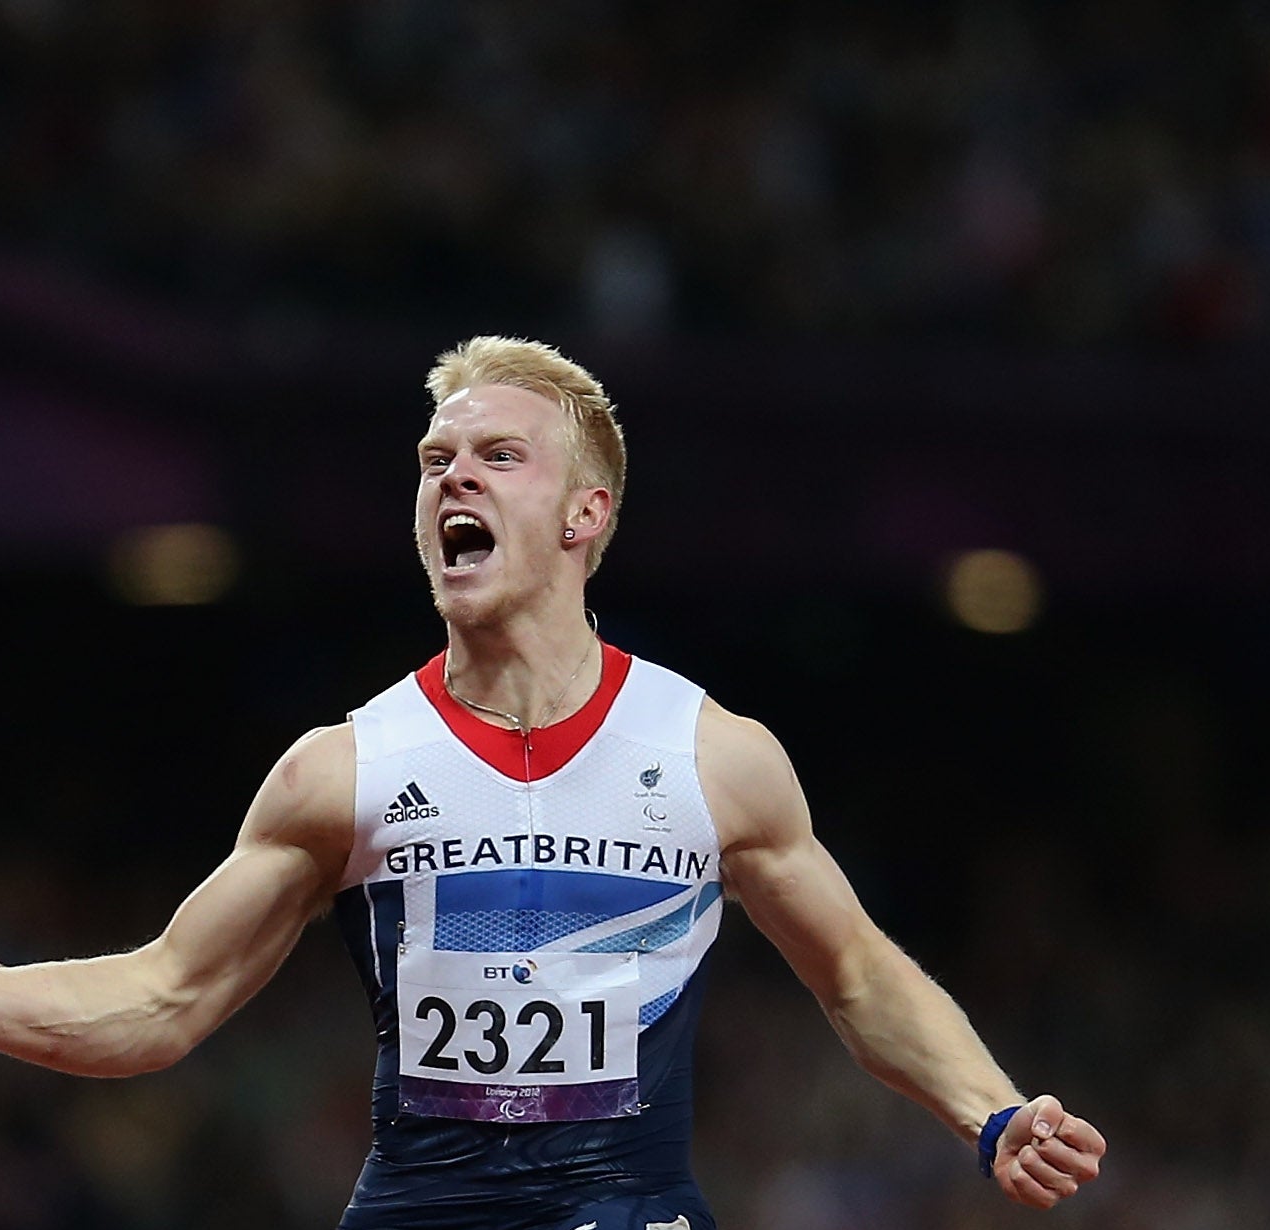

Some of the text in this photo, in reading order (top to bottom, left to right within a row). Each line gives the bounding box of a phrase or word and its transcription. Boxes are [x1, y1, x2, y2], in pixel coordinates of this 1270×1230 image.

[384, 804, 440, 824] adidas
[484, 966, 510, 979] BT
[415, 996, 606, 1075] 2321
